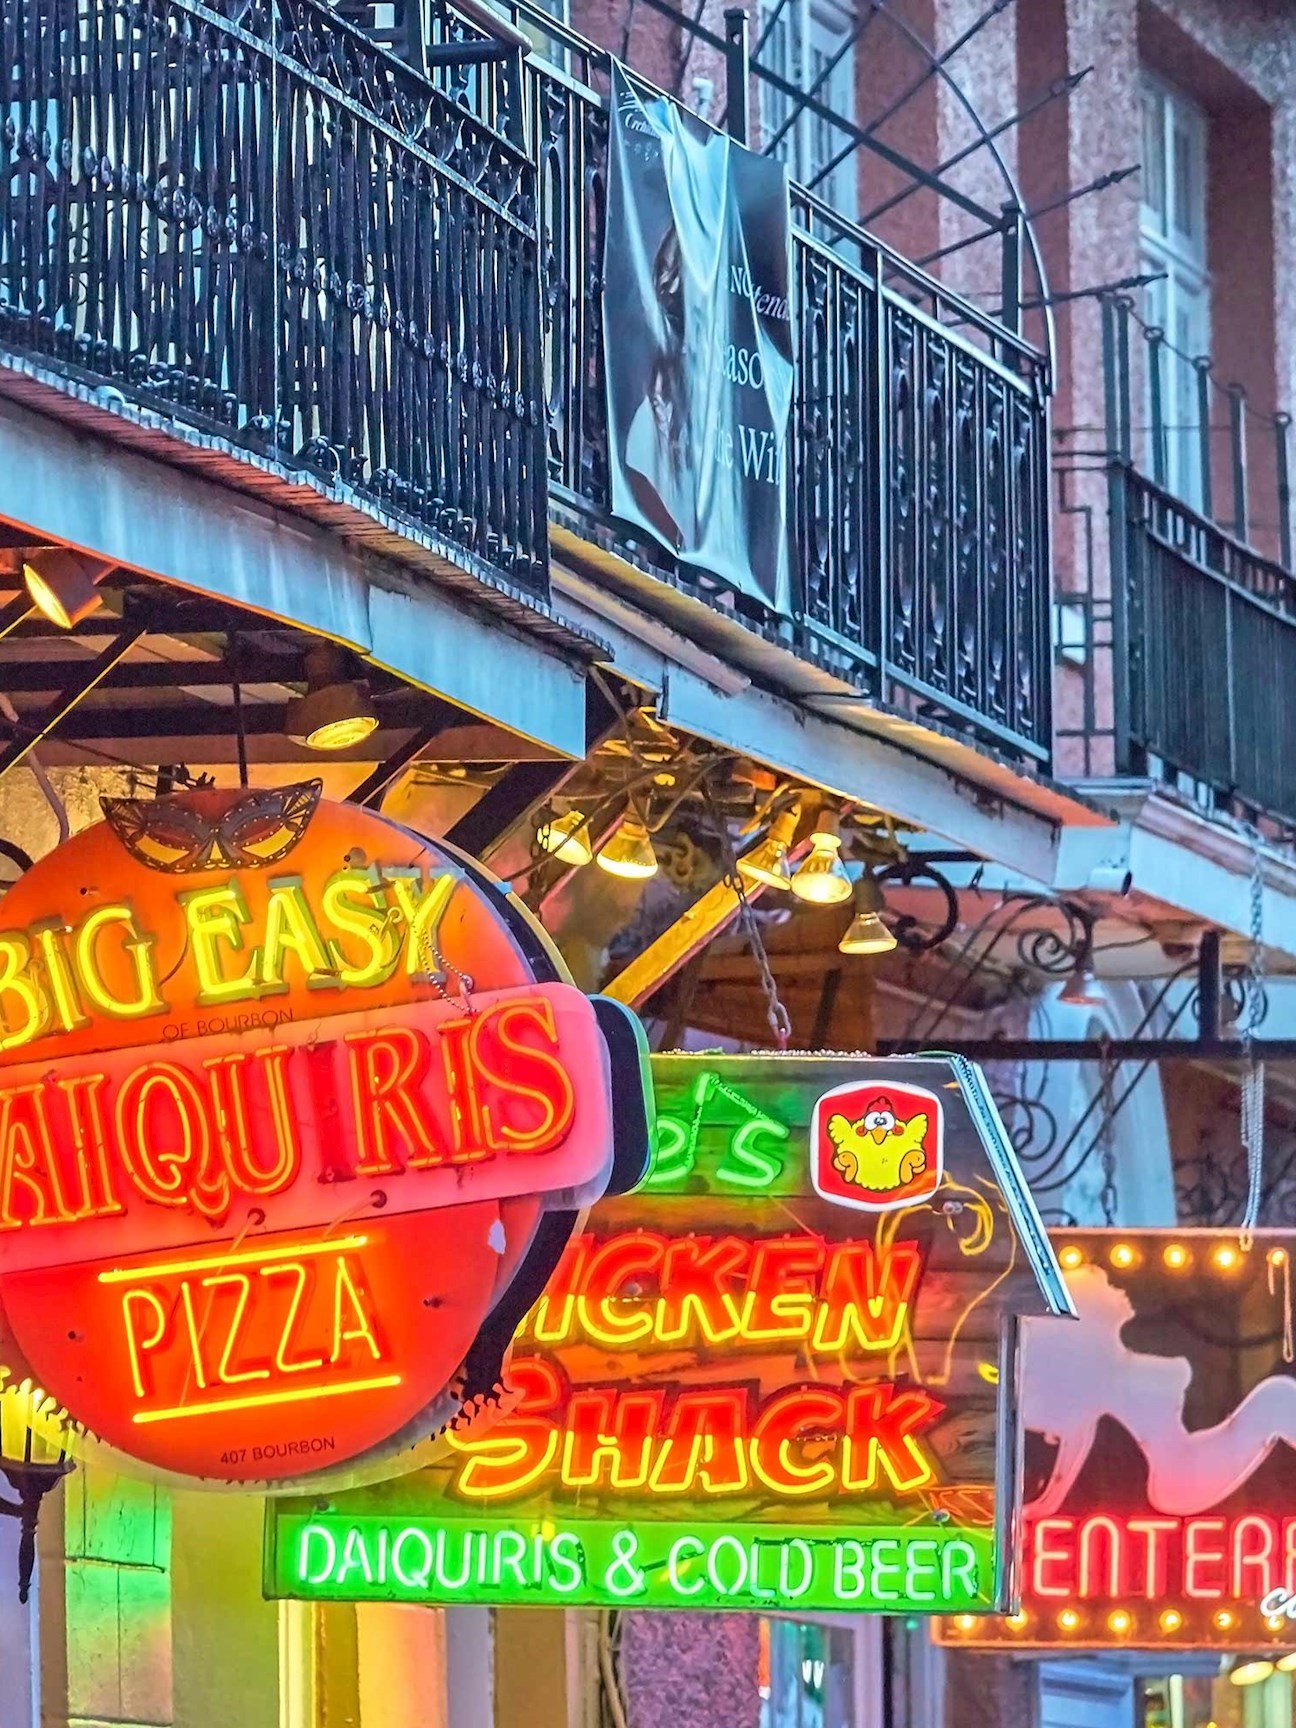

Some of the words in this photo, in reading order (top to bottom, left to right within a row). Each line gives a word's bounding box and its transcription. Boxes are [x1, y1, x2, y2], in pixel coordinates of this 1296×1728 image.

[186, 868, 460, 999] EASY
[162, 1022, 191, 1041] OF
[197, 1008, 293, 1037] BOURBON
[122, 1256, 384, 1400] PIZZA
[513, 1232, 921, 1352] ICKEN
[220, 1448, 247, 1465] 407
[252, 1436, 336, 1461] BOURBON
[447, 1357, 945, 1497] SHACK
[297, 1527, 585, 1592] DAIQUIRIS
[612, 1529, 646, 1597] &
[668, 1534, 814, 1600] COLD
[833, 1539, 980, 1601] BEER
